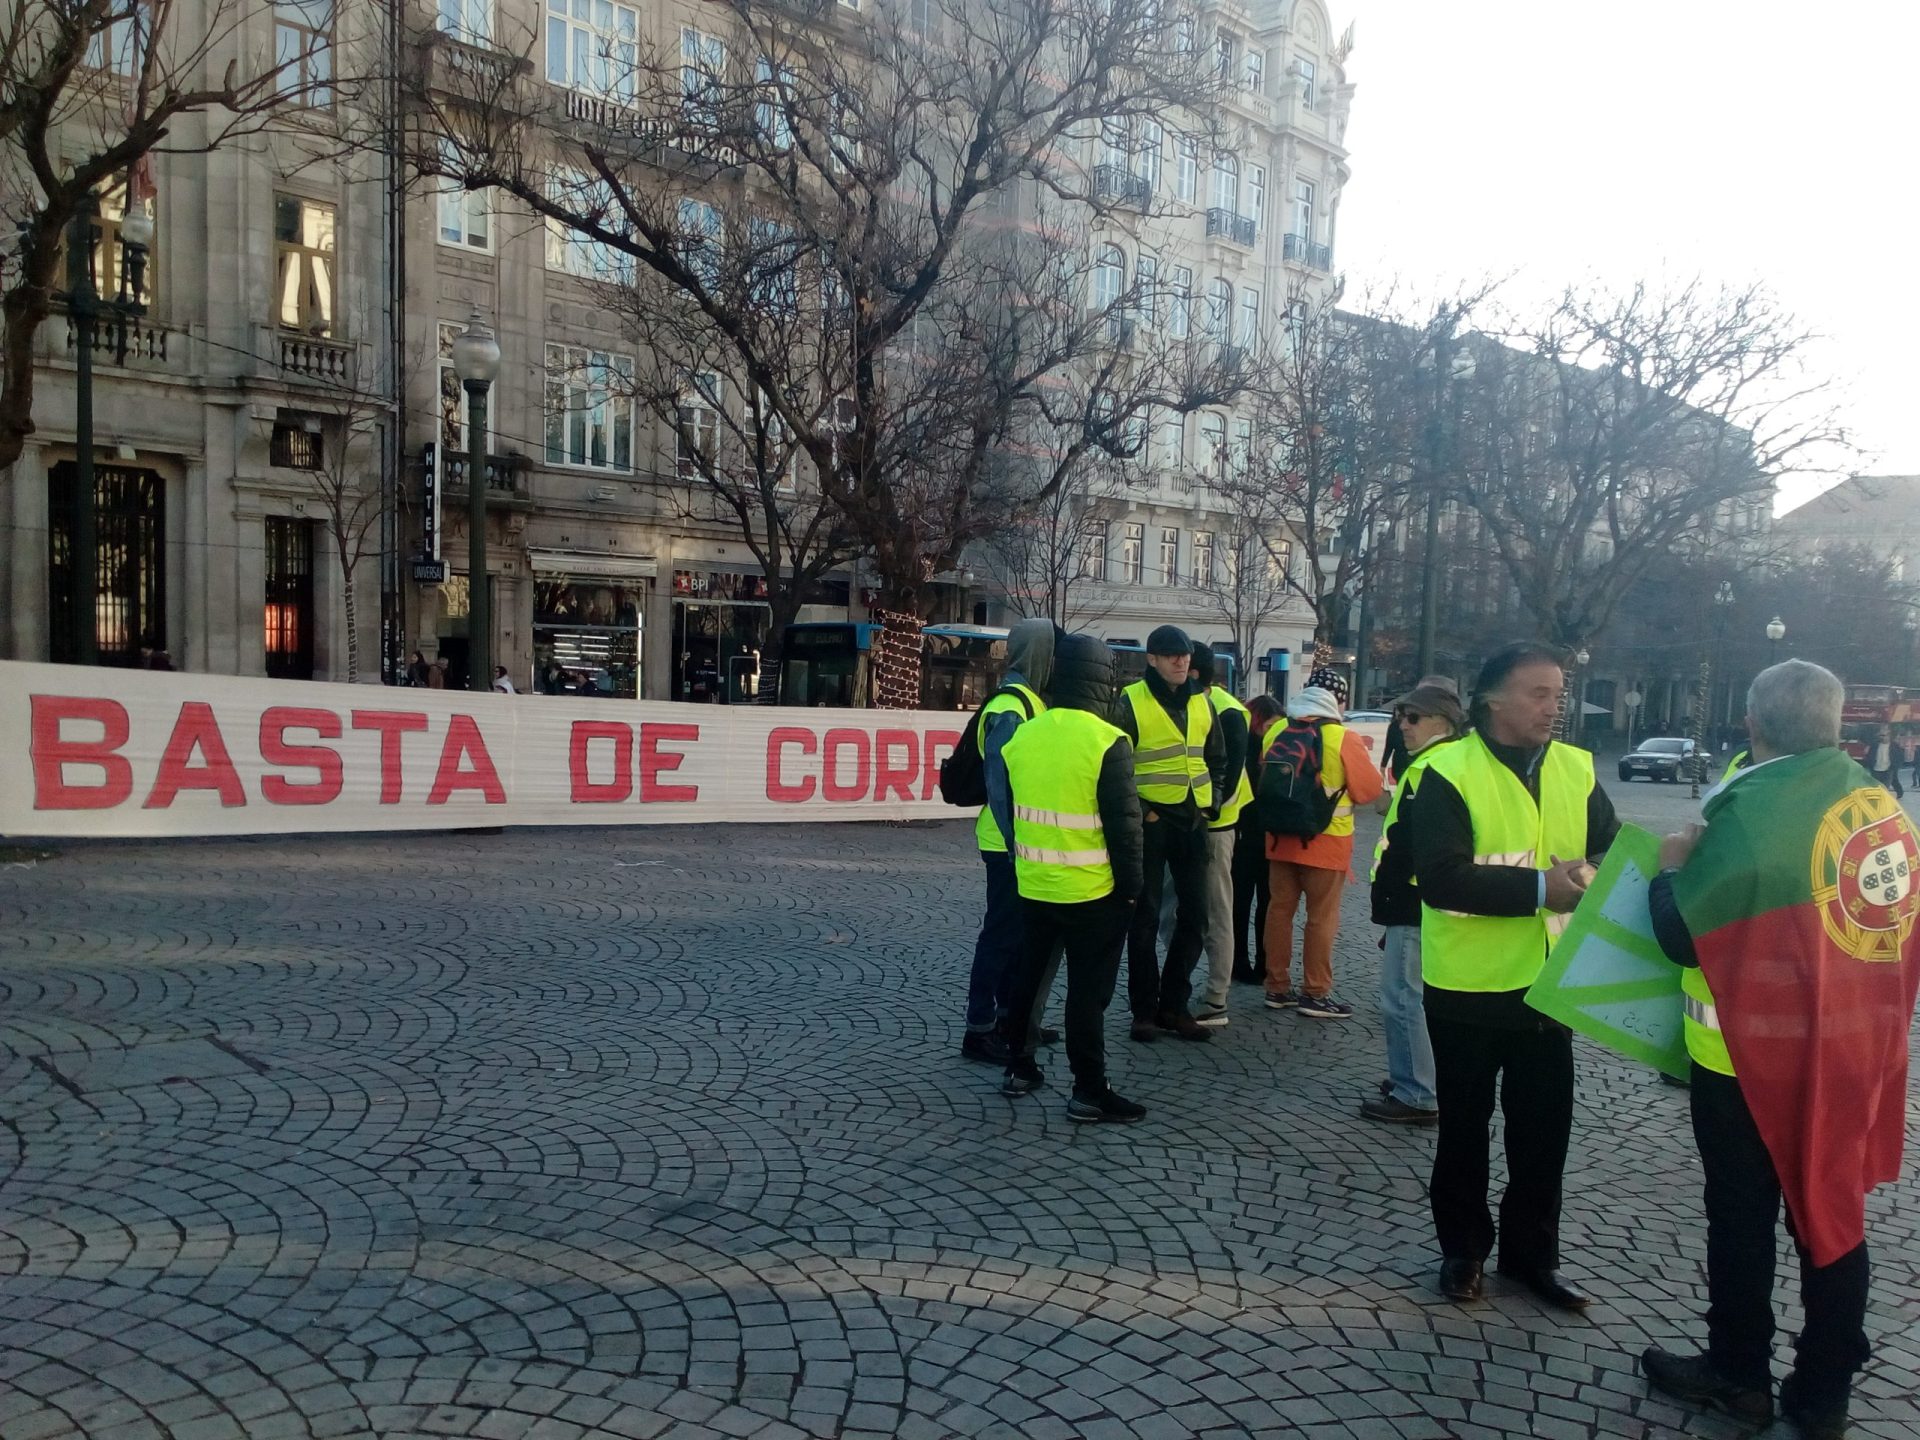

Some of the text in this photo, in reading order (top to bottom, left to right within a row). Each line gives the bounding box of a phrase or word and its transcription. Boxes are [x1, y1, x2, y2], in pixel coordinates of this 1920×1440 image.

[425, 452, 433, 552] HOTEL
[414, 566, 442, 579] UNIVERSAL
[691, 578, 709, 591] BPI
[29, 694, 508, 810] BASTA
[569, 720, 700, 803] DE
